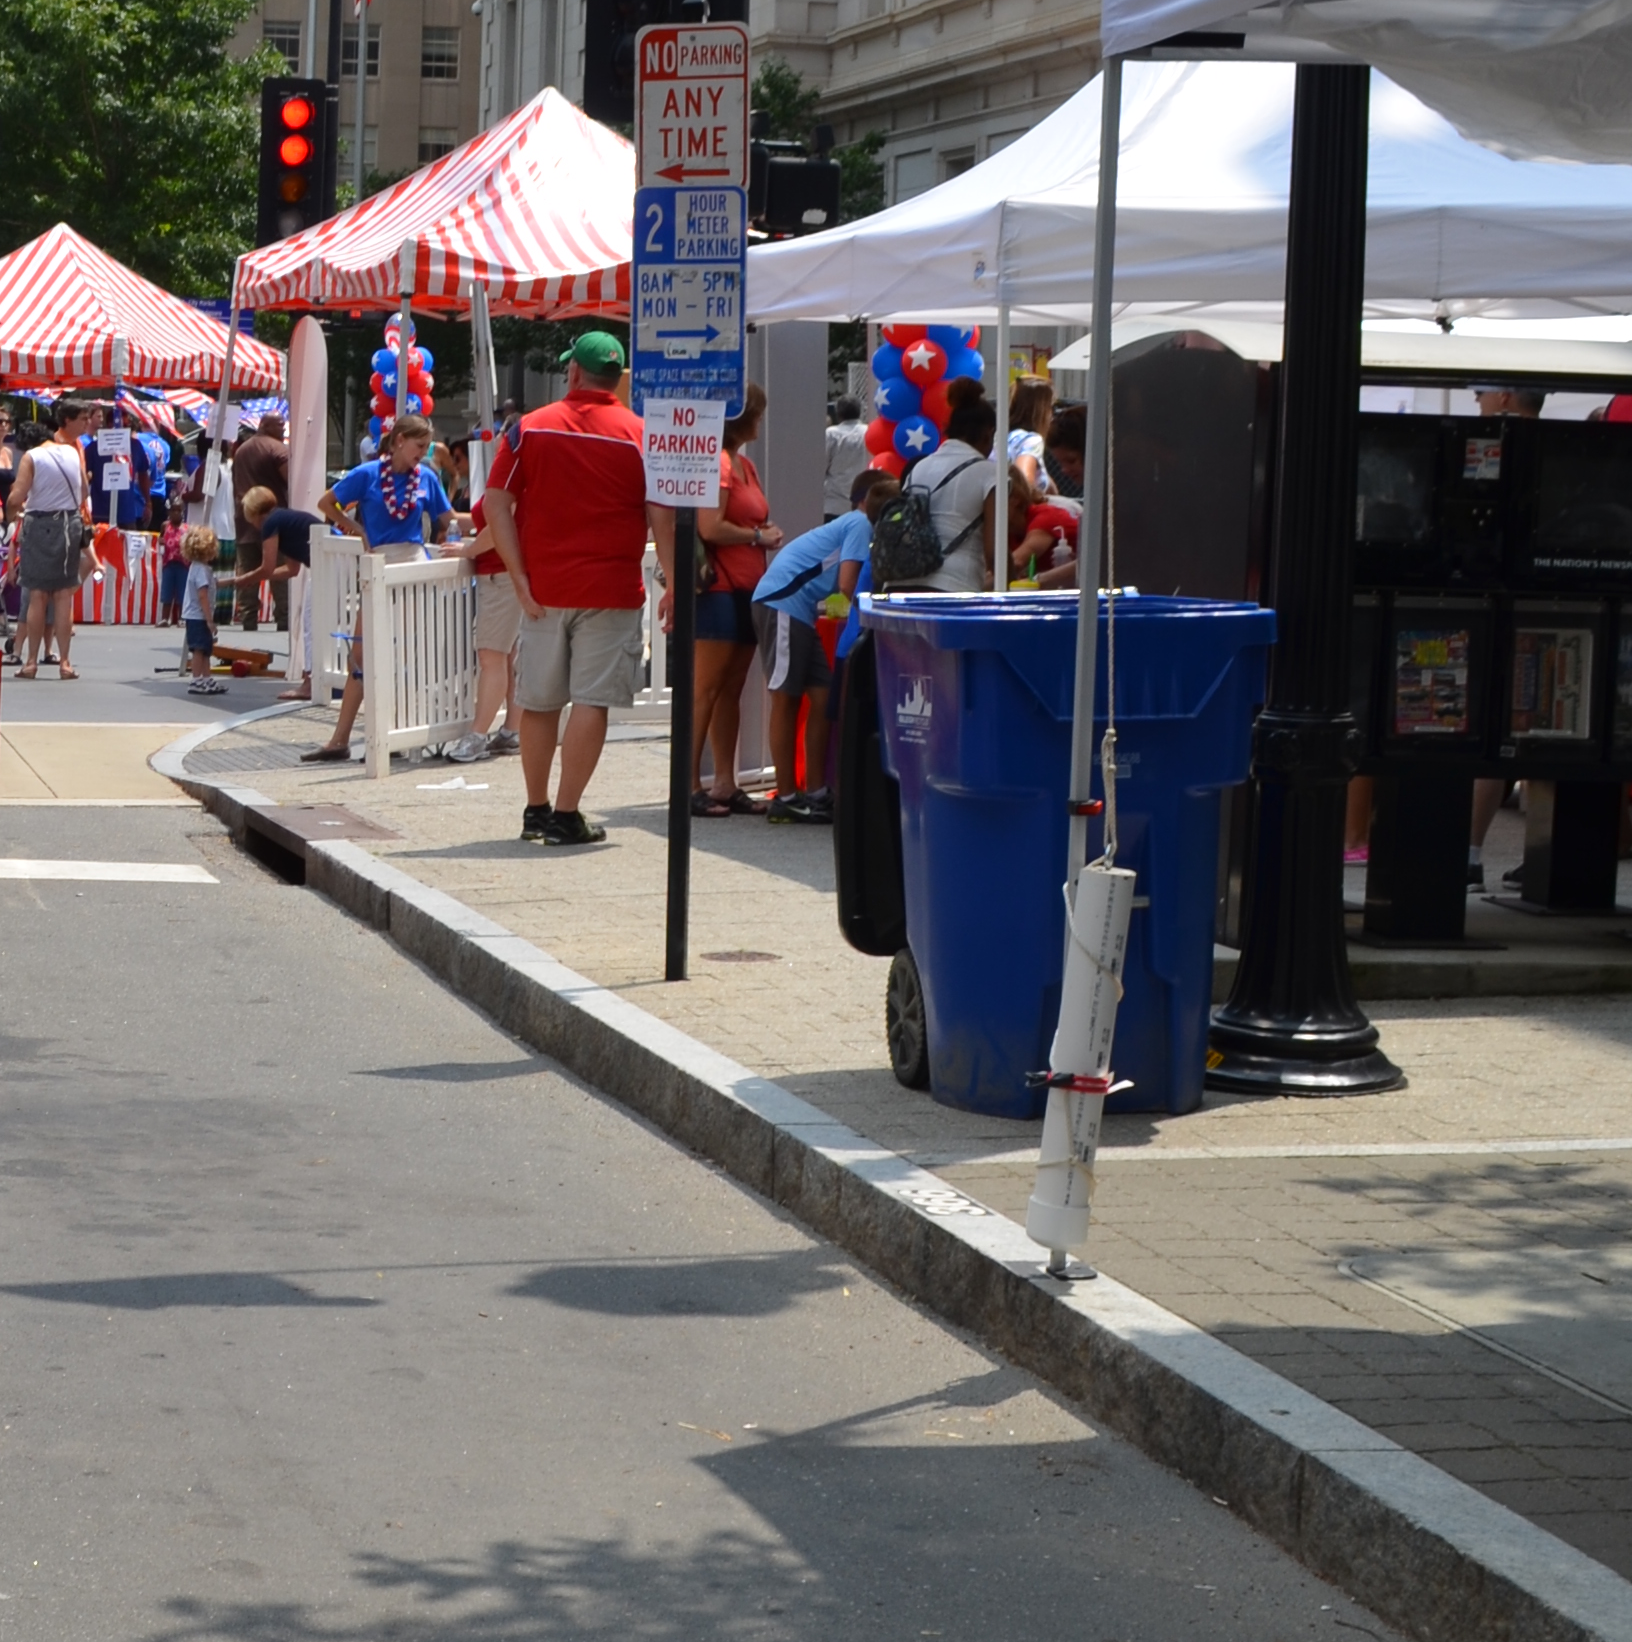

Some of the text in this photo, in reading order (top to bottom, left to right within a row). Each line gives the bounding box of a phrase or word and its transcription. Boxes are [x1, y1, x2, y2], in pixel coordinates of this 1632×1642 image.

[646, 40, 742, 74] NO PARKING
[662, 86, 724, 119] ANY
[658, 126, 728, 158] TIME
[645, 194, 727, 252] 2 HOUR
[687, 216, 729, 235] METER
[677, 238, 738, 257] PARKING
[641, 271, 674, 293] 8AM
[703, 270, 735, 292] 5PM
[642, 297, 677, 317] MON
[706, 296, 732, 317] FRI
[673, 407, 695, 427] NO
[648, 433, 717, 454] PARKING
[656, 478, 706, 496] POLICE
[1533, 557, 1551, 567] THE
[1552, 558, 1599, 569] NATION'S
